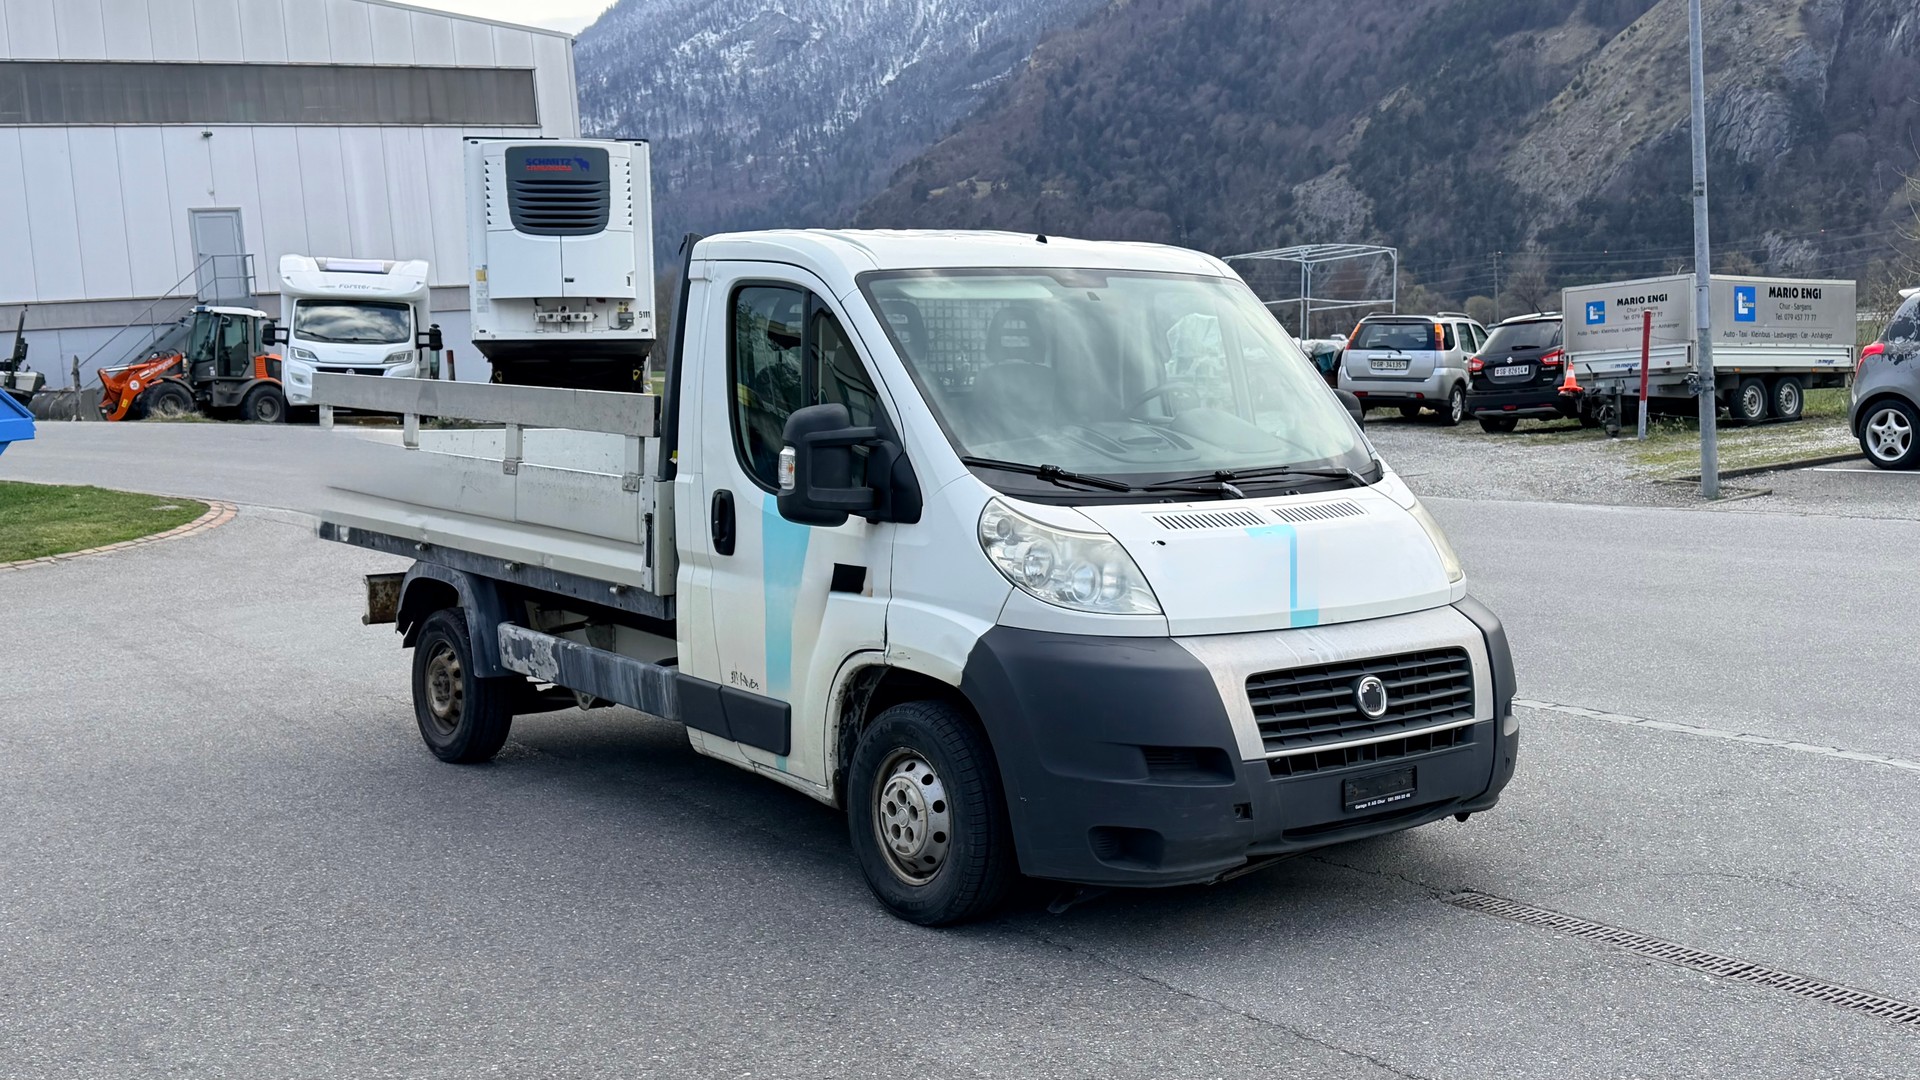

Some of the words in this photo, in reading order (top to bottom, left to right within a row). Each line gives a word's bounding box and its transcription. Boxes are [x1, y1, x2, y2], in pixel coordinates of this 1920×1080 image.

[526, 158, 572, 166] SCHMITZ
[1769, 286, 1799, 299] MARIO
[1801, 287, 1822, 299] ENGI
[1616, 296, 1645, 307] MARIO
[1647, 293, 1668, 304] ENGI
